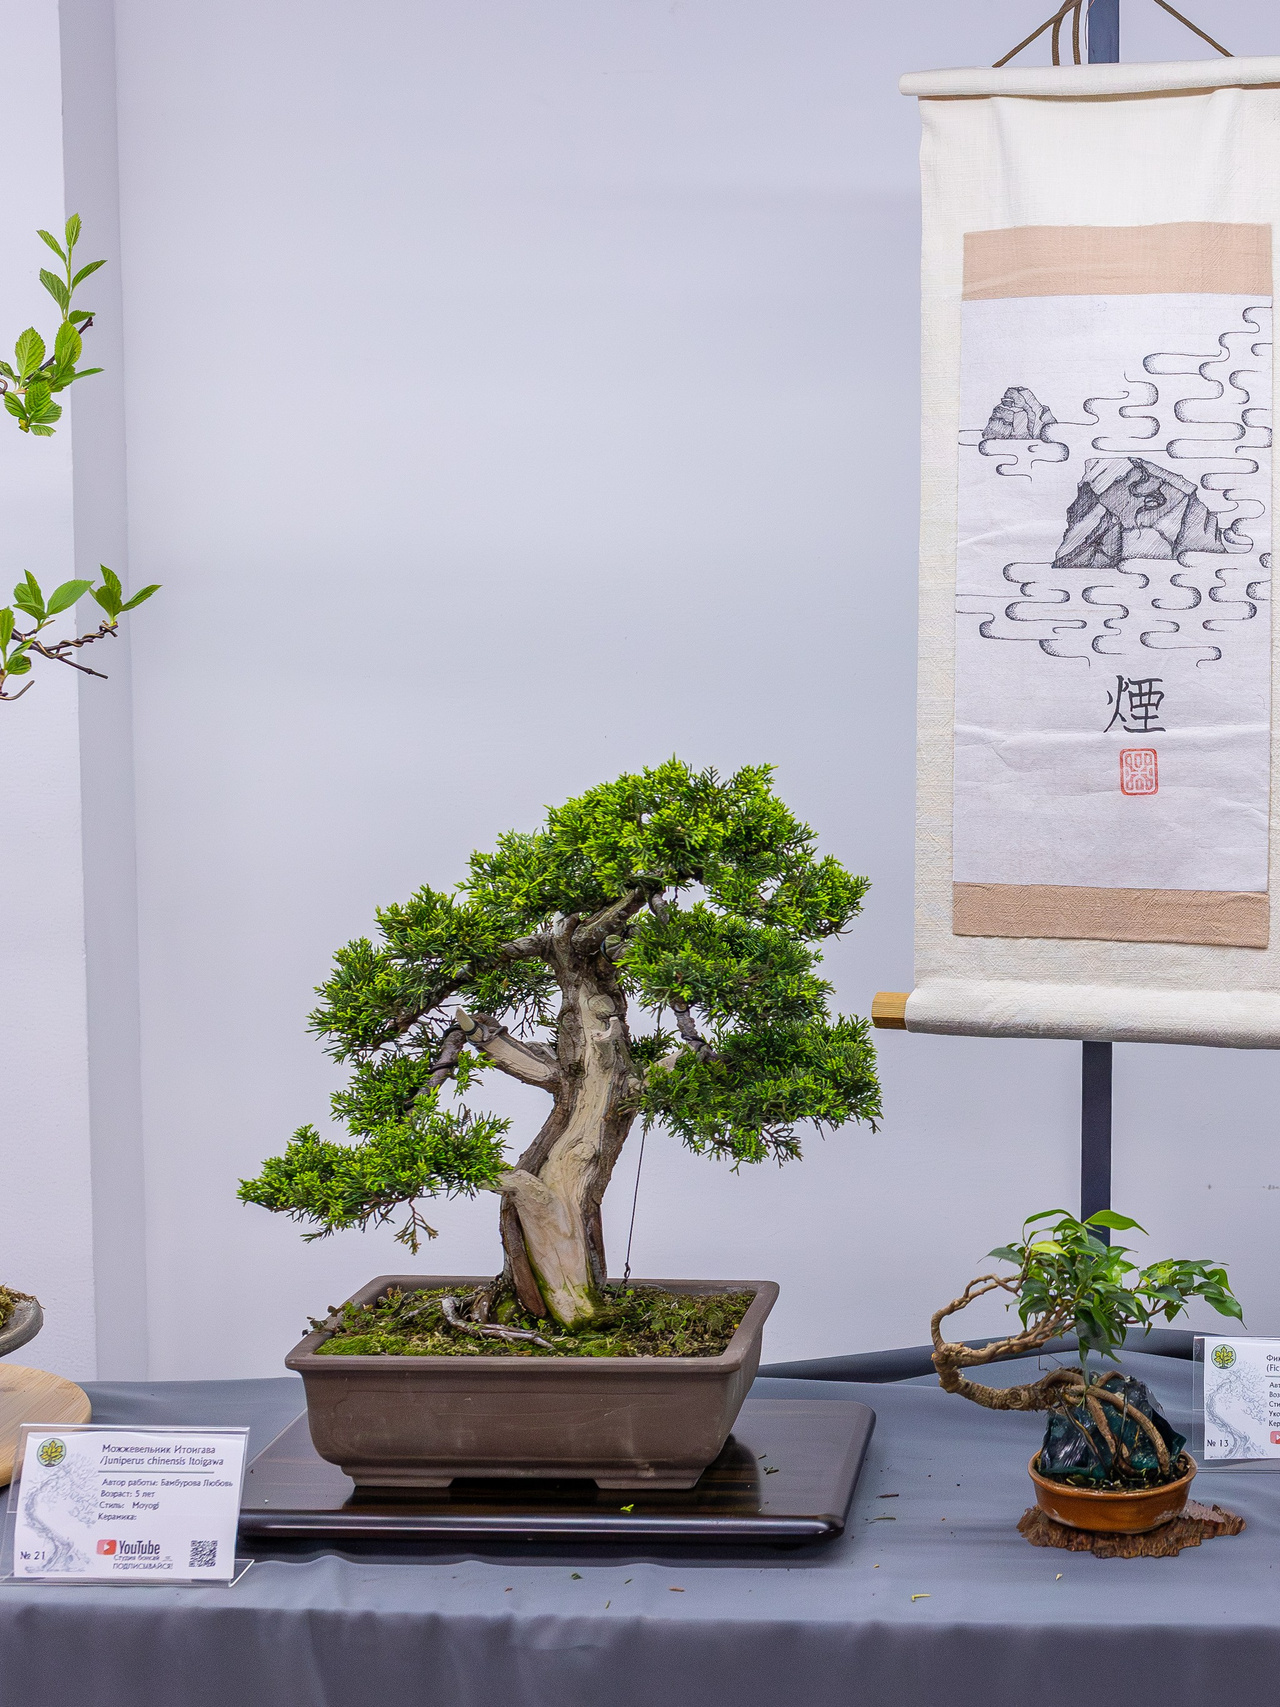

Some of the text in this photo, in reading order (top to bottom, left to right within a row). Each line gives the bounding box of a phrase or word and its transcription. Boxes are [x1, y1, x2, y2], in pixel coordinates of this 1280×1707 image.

[1103, 674, 1167, 733] 煙
[1219, 1439, 1229, 1447] 13
[101, 1444, 216, 1454] Можжевельник Итоигава
[146, 1456, 186, 1466] chinensis
[188, 1456, 224, 1467] Itoigawa
[101, 1478, 234, 1488] Автор работы: Бамбурова Любовь
[100, 1489, 133, 1498] Возраст:
[134, 1489, 140, 1498] 5
[98, 1501, 160, 1511] Стиль: Moyogi
[97, 1512, 138, 1521] Керамика:
[119, 1540, 161, 1555] YouTube
[20, 1551, 46, 1560] № 21
[114, 1554, 136, 1562] Студия
[112, 1562, 173, 1570] ПОДПИСЫВАЙСЯ!
